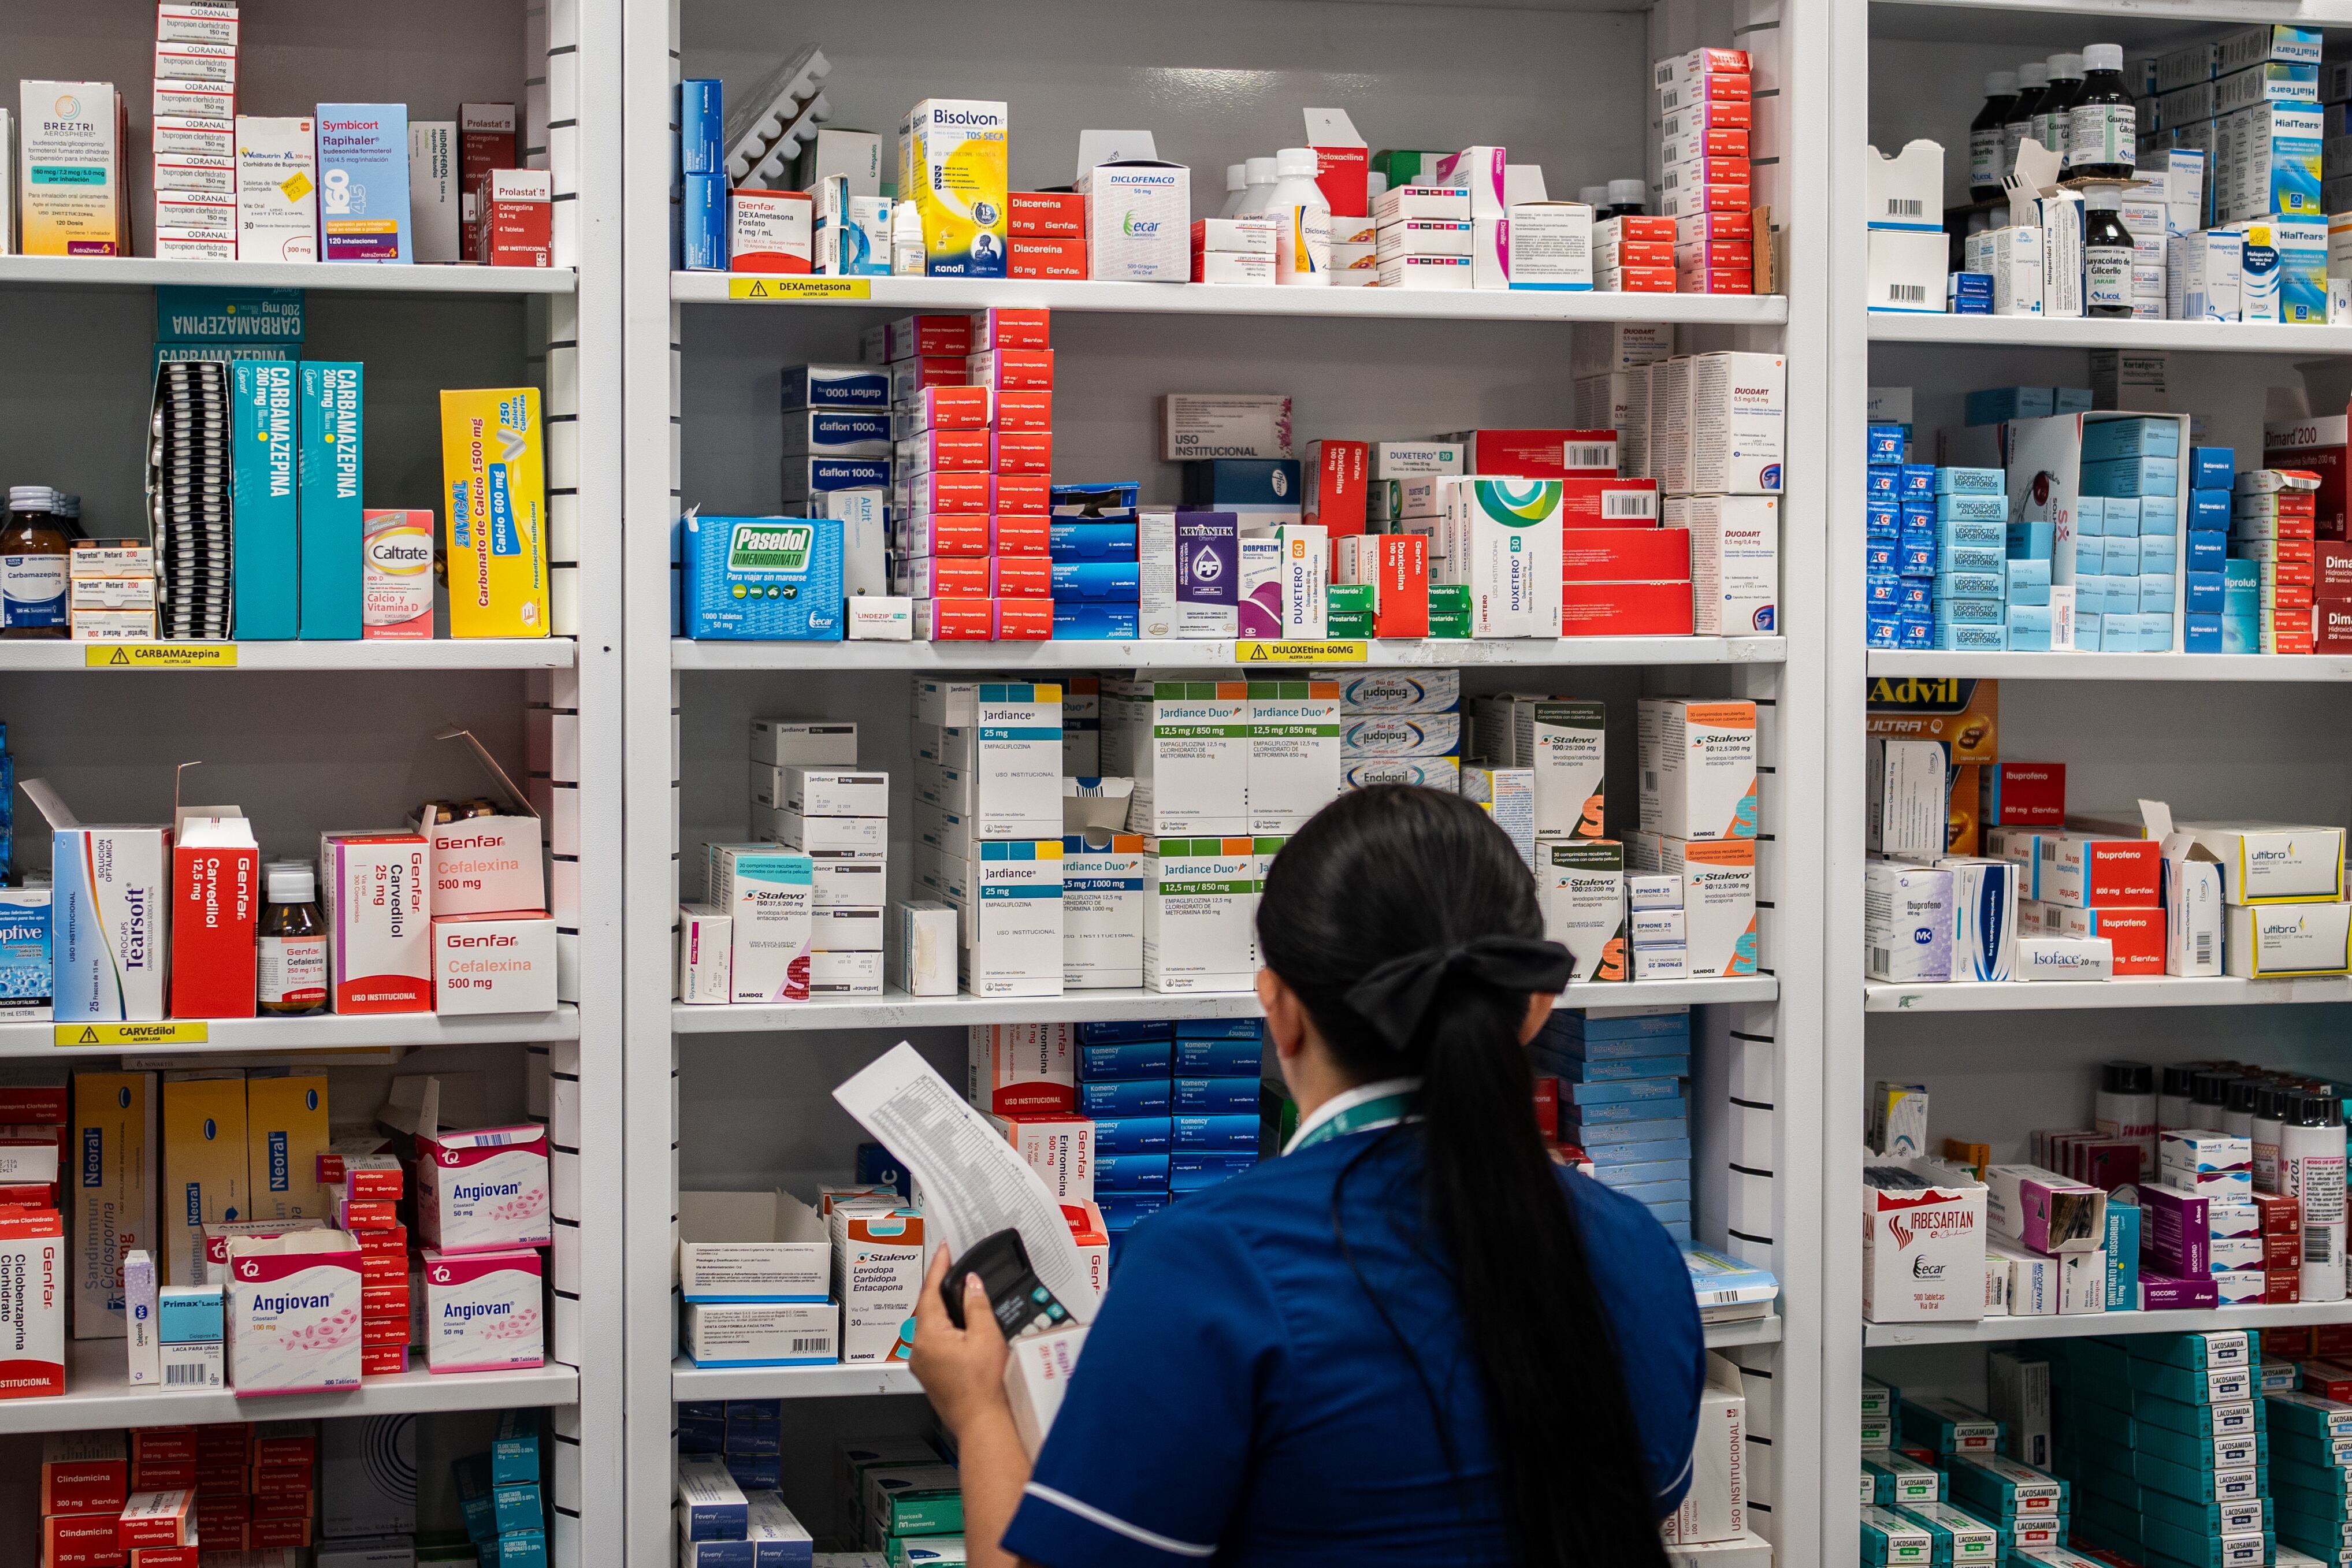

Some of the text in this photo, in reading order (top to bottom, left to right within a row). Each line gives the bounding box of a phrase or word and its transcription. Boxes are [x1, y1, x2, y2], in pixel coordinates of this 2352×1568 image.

[191, 9, 230, 17] ODRANAL
[167, 20, 230, 30] bupropion clorhidrato
[934, 109, 998, 125] Bisolvon
[44, 122, 93, 131] BREZTRI
[322, 121, 378, 132] Symbicort
[984, 132, 1004, 140] SECA
[242, 151, 281, 159] Wellbutrin
[1110, 176, 1175, 184] DICLOFENACO
[1012, 199, 1061, 209] Diacereína
[738, 211, 794, 221] DEXAmetasona
[738, 219, 765, 227] Fosfato
[1133, 222, 1160, 232] ecar
[2048, 228, 2052, 239] mg
[935, 264, 964, 273] sanofi
[779, 283, 851, 292] DEXAmetasona
[172, 317, 300, 335] CARBAMAZEPINA
[254, 367, 269, 406] 200 mg
[321, 370, 335, 408] 200 mg
[1734, 388, 1768, 396] DUODART
[500, 402, 510, 425] 250
[270, 367, 289, 497] CARBAMAZEPINA
[337, 370, 356, 499] CARBAMAZEPINA
[1175, 435, 1199, 445] USO
[1175, 447, 1258, 457] INSTITUCIONAL
[1275, 471, 1285, 497] Pfizer
[470, 418, 489, 607] Carbonato de Calcio 1500 mg
[1180, 525, 1233, 537] KRYTANTEK
[736, 529, 805, 551] Pasedol
[373, 546, 427, 560] Caltrate
[1243, 544, 1279, 552] DORPRETIM
[733, 553, 801, 566] DIMENHIDRINATO
[1389, 557, 1395, 566] mg
[747, 573, 762, 582] viajar
[135, 650, 220, 658] CARBAMAzepina
[1272, 645, 1354, 655] DULOXEtina 60MG
[1363, 688, 1407, 700] Enalapril
[1867, 678, 1958, 703] Advil
[1160, 708, 1199, 719] Jardiance
[2006, 771, 2048, 781] Ibuprofeno
[2097, 850, 2141, 860] Ibuprofeno
[2252, 851, 2286, 859] ultibro
[438, 860, 519, 874] Cefalexina
[191, 859, 203, 901] 12,5 mg
[374, 865, 387, 906] 25 mg
[206, 858, 220, 928] Carvedilol
[391, 864, 403, 938] Carvedilol
[367, 993, 417, 1001] INSTITUCIONAL
[120, 1026, 175, 1036] CARVEdilol
[1019, 1097, 1061, 1105] INSTITUCIONAL
[85, 1134, 99, 1184] Neoral
[1047, 1153, 1055, 1166] mg
[1059, 1135, 1068, 1197] Eritromicina
[1911, 1211, 1973, 1229] IRBESARTAN
[101, 1202, 118, 1289] Ciclosporina
[2108, 1215, 2119, 1306] DINITRATO DE ISOSORBIDE
[853, 1266, 894, 1276] Levodopa
[853, 1275, 897, 1284] Carbidopa
[1, 1255, 11, 1322] Clorhidrato
[853, 1283, 903, 1293] Entacapona
[14, 1254, 25, 1351] Ciclobenzaprina
[2211, 1340, 2244, 1350] LACOSAMIDA
[2213, 1374, 2246, 1384] LACOSAMIDA
[57, 1474, 110, 1482] Clindamicina
[2018, 1489, 2057, 1498] LACOSAMIDA
